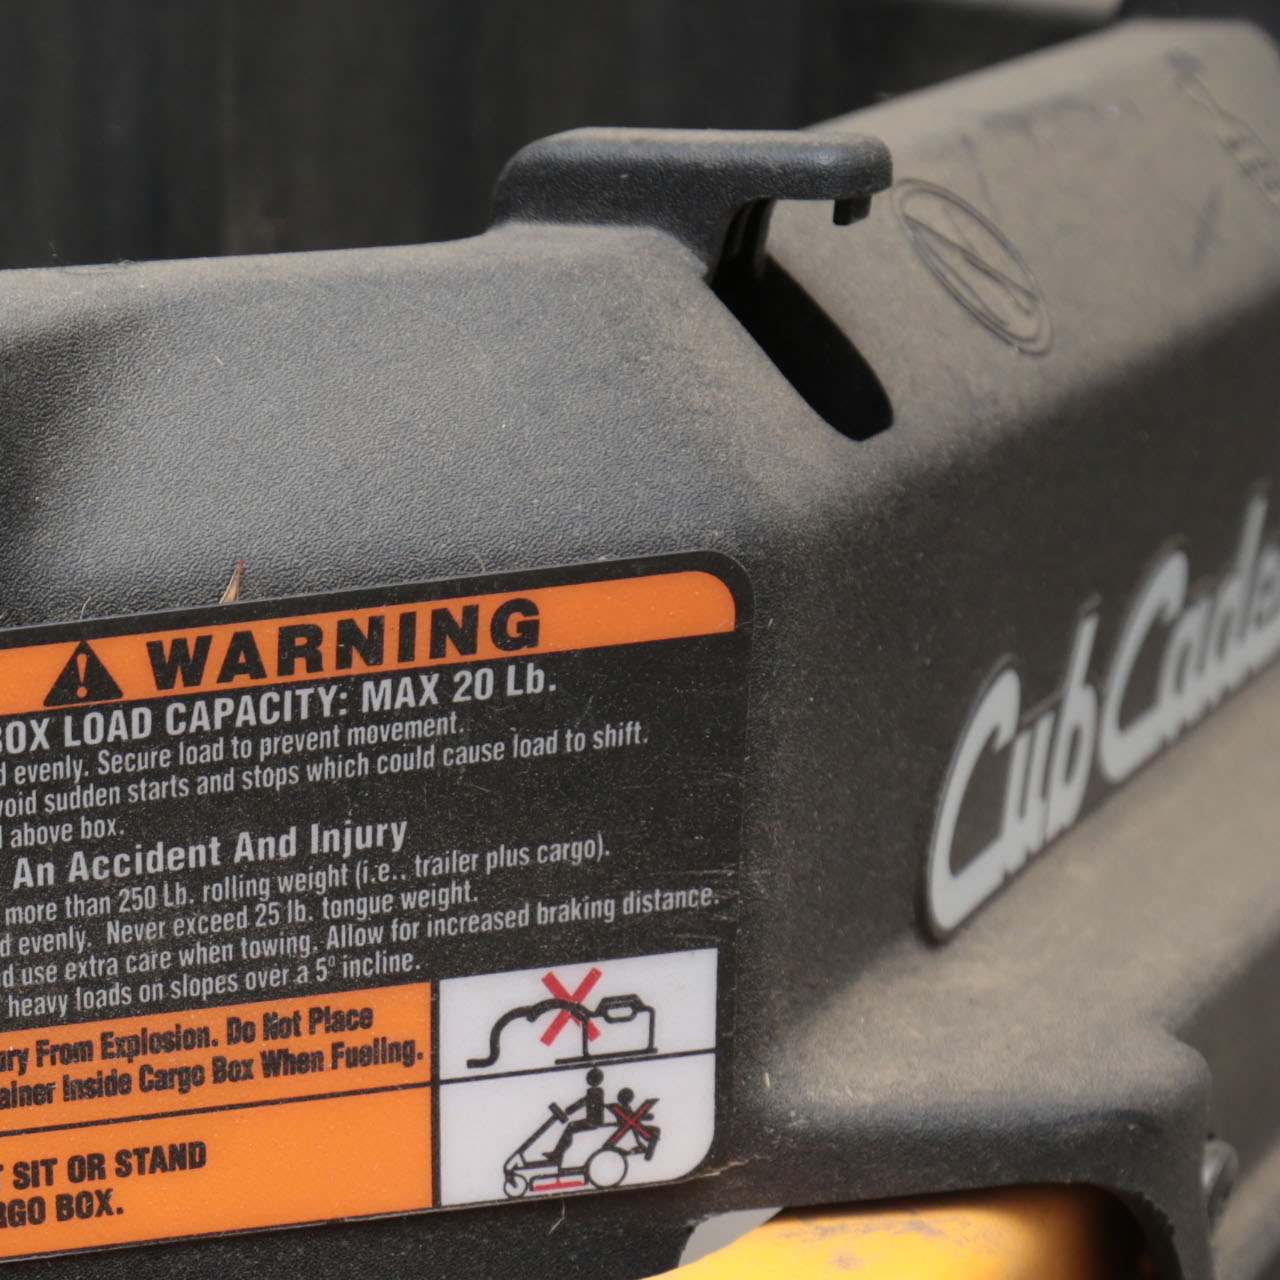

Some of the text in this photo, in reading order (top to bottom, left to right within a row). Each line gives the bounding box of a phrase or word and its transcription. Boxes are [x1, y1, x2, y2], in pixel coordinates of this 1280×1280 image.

[146, 598, 540, 692] WARNING
[64, 706, 152, 748] LOAD
[165, 685, 347, 736] CAPACITY:
[361, 673, 440, 713] MAX
[452, 667, 494, 703] 20
[506, 662, 556, 697] Lb.
[927, 494, 1280, 931] Cub Cade
[14, 754, 89, 785] evenly.
[97, 748, 172, 775] Secure
[179, 736, 224, 765] load
[231, 736, 253, 760] to
[259, 724, 341, 762] prevent
[347, 711, 464, 747] movement.
[44, 783, 121, 815] sudden
[127, 774, 190, 803] starts
[196, 766, 235, 796] and
[241, 764, 299, 791] stops
[306, 752, 369, 782] which
[376, 743, 435, 775] could
[442, 741, 505, 767] cause
[513, 729, 558, 758] load
[565, 729, 586, 753] to
[592, 720, 648, 750] shift.
[10, 822, 73, 849] above
[80, 815, 124, 840] box.
[13, 857, 55, 890] An
[67, 836, 221, 883] Accident
[233, 825, 297, 864] And
[310, 819, 407, 859] Injury
[5, 901, 57, 926] more
[64, 893, 111, 919] than
[118, 884, 158, 914] 250
[162, 881, 195, 908] Lb.
[203, 874, 270, 903] rolling
[277, 863, 349, 896] weight
[414, 849, 479, 878] trailer
[485, 844, 530, 876] plus
[537, 833, 610, 866] cargo).
[18, 925, 92, 956] evenly.
[106, 919, 166, 945] Never
[172, 905, 250, 938] exceed
[254, 901, 281, 928] 25
[287, 898, 313, 924] lb.
[321, 893, 394, 922] tongue
[400, 879, 478, 912] weight.
[21, 963, 58, 986] use
[64, 954, 119, 981] extra
[125, 950, 172, 974] care
[178, 940, 234, 968] when
[240, 931, 318, 960] towing.
[326, 923, 384, 950] Allow
[390, 917, 420, 942] for
[427, 902, 530, 938] increased
[536, 895, 616, 925] braking
[622, 887, 719, 916] distance.
[8, 994, 68, 1019] heavy
[74, 981, 132, 1012] loads
[138, 982, 164, 1003] on
[170, 972, 239, 1001] slopes
[244, 963, 290, 991] over
[292, 965, 310, 985] a
[342, 949, 420, 979] incline.
[35, 1039, 94, 1068] From
[100, 1023, 219, 1063] Explosion.
[226, 1016, 256, 1046] Do
[262, 1010, 302, 1041] Not
[308, 1005, 374, 1035] Place
[62, 1068, 133, 1102] Inside
[138, 1064, 206, 1094] Cargo
[211, 1055, 254, 1084] Box
[259, 1048, 325, 1079] When
[331, 1036, 424, 1070] Fueling.
[12, 1157, 58, 1191] SIT
[67, 1152, 107, 1184] OR
[115, 1141, 207, 1178] STAND
[55, 1188, 124, 1222] BOX.
